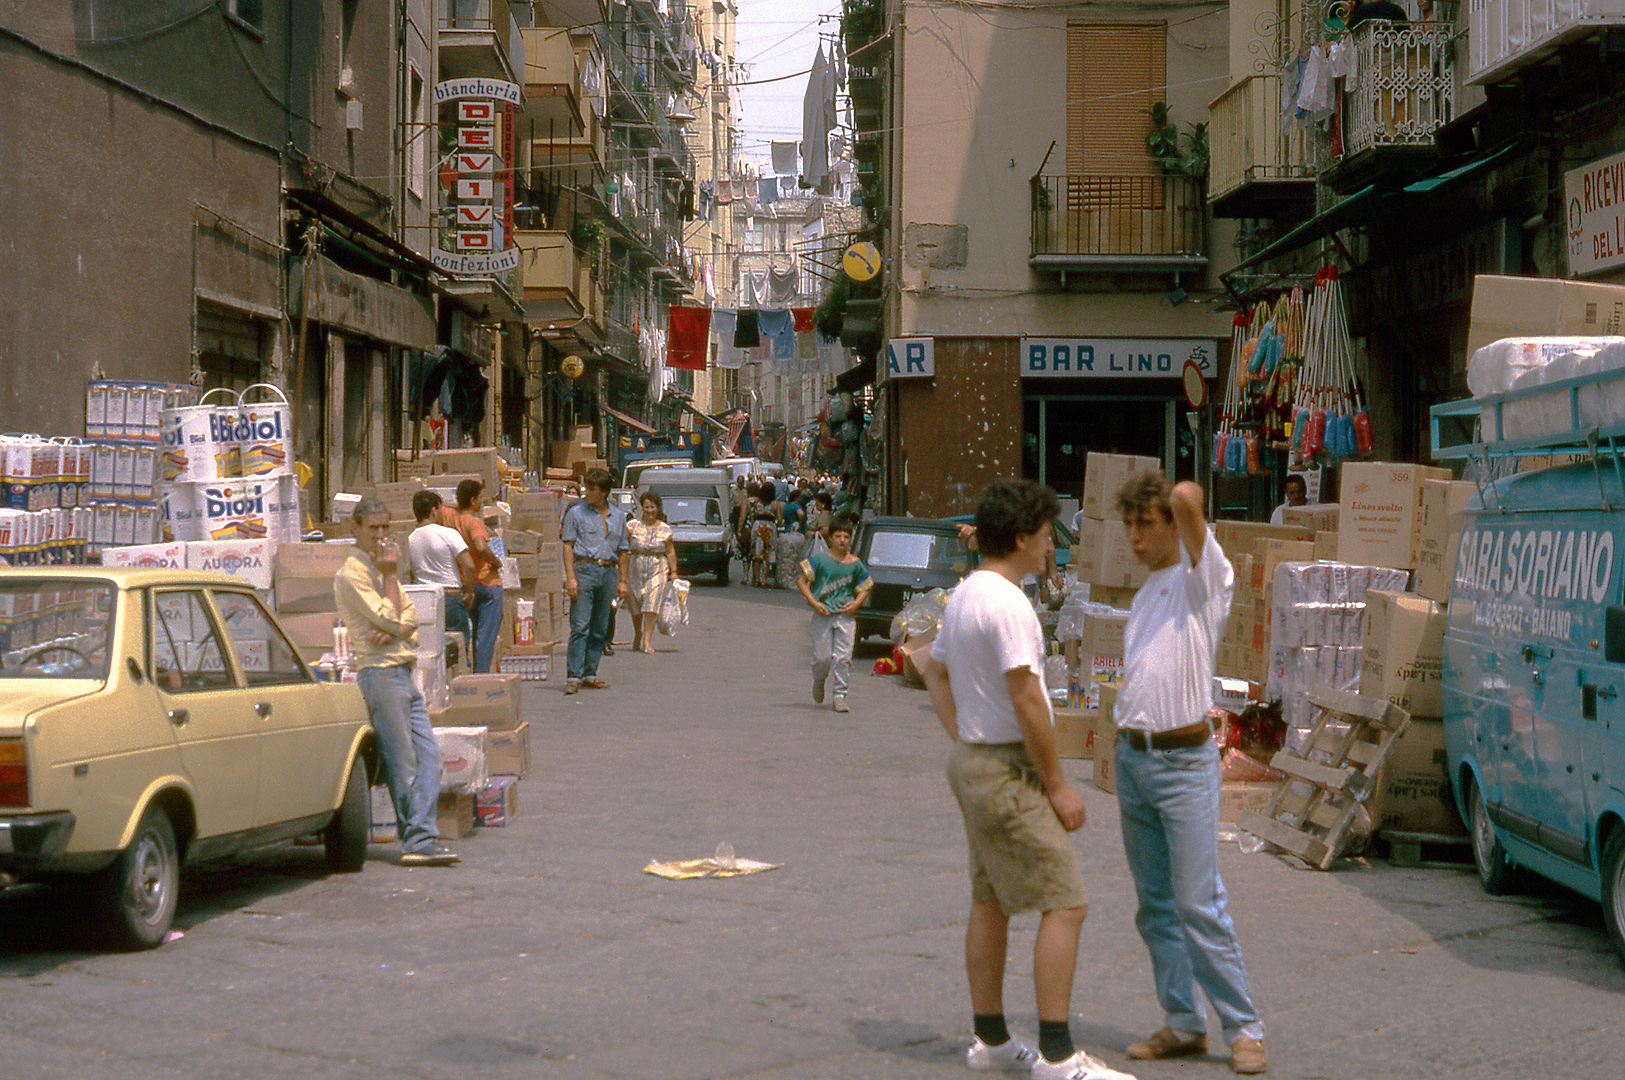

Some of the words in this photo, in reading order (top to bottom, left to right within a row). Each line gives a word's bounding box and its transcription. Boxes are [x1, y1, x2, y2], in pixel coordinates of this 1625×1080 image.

[434, 79, 518, 100] biancheria
[1584, 162, 1625, 213] RICEVI
[1593, 231, 1613, 260] DEL
[1616, 215, 1625, 255] L
[433, 251, 516, 271] confezioni
[1029, 345, 1095, 371] BAR
[1109, 353, 1172, 371] LINO
[241, 410, 282, 441] Biol
[1391, 472, 1409, 482] 359
[203, 556, 262, 570] AURORA
[1093, 655, 1116, 667] ARIEL
